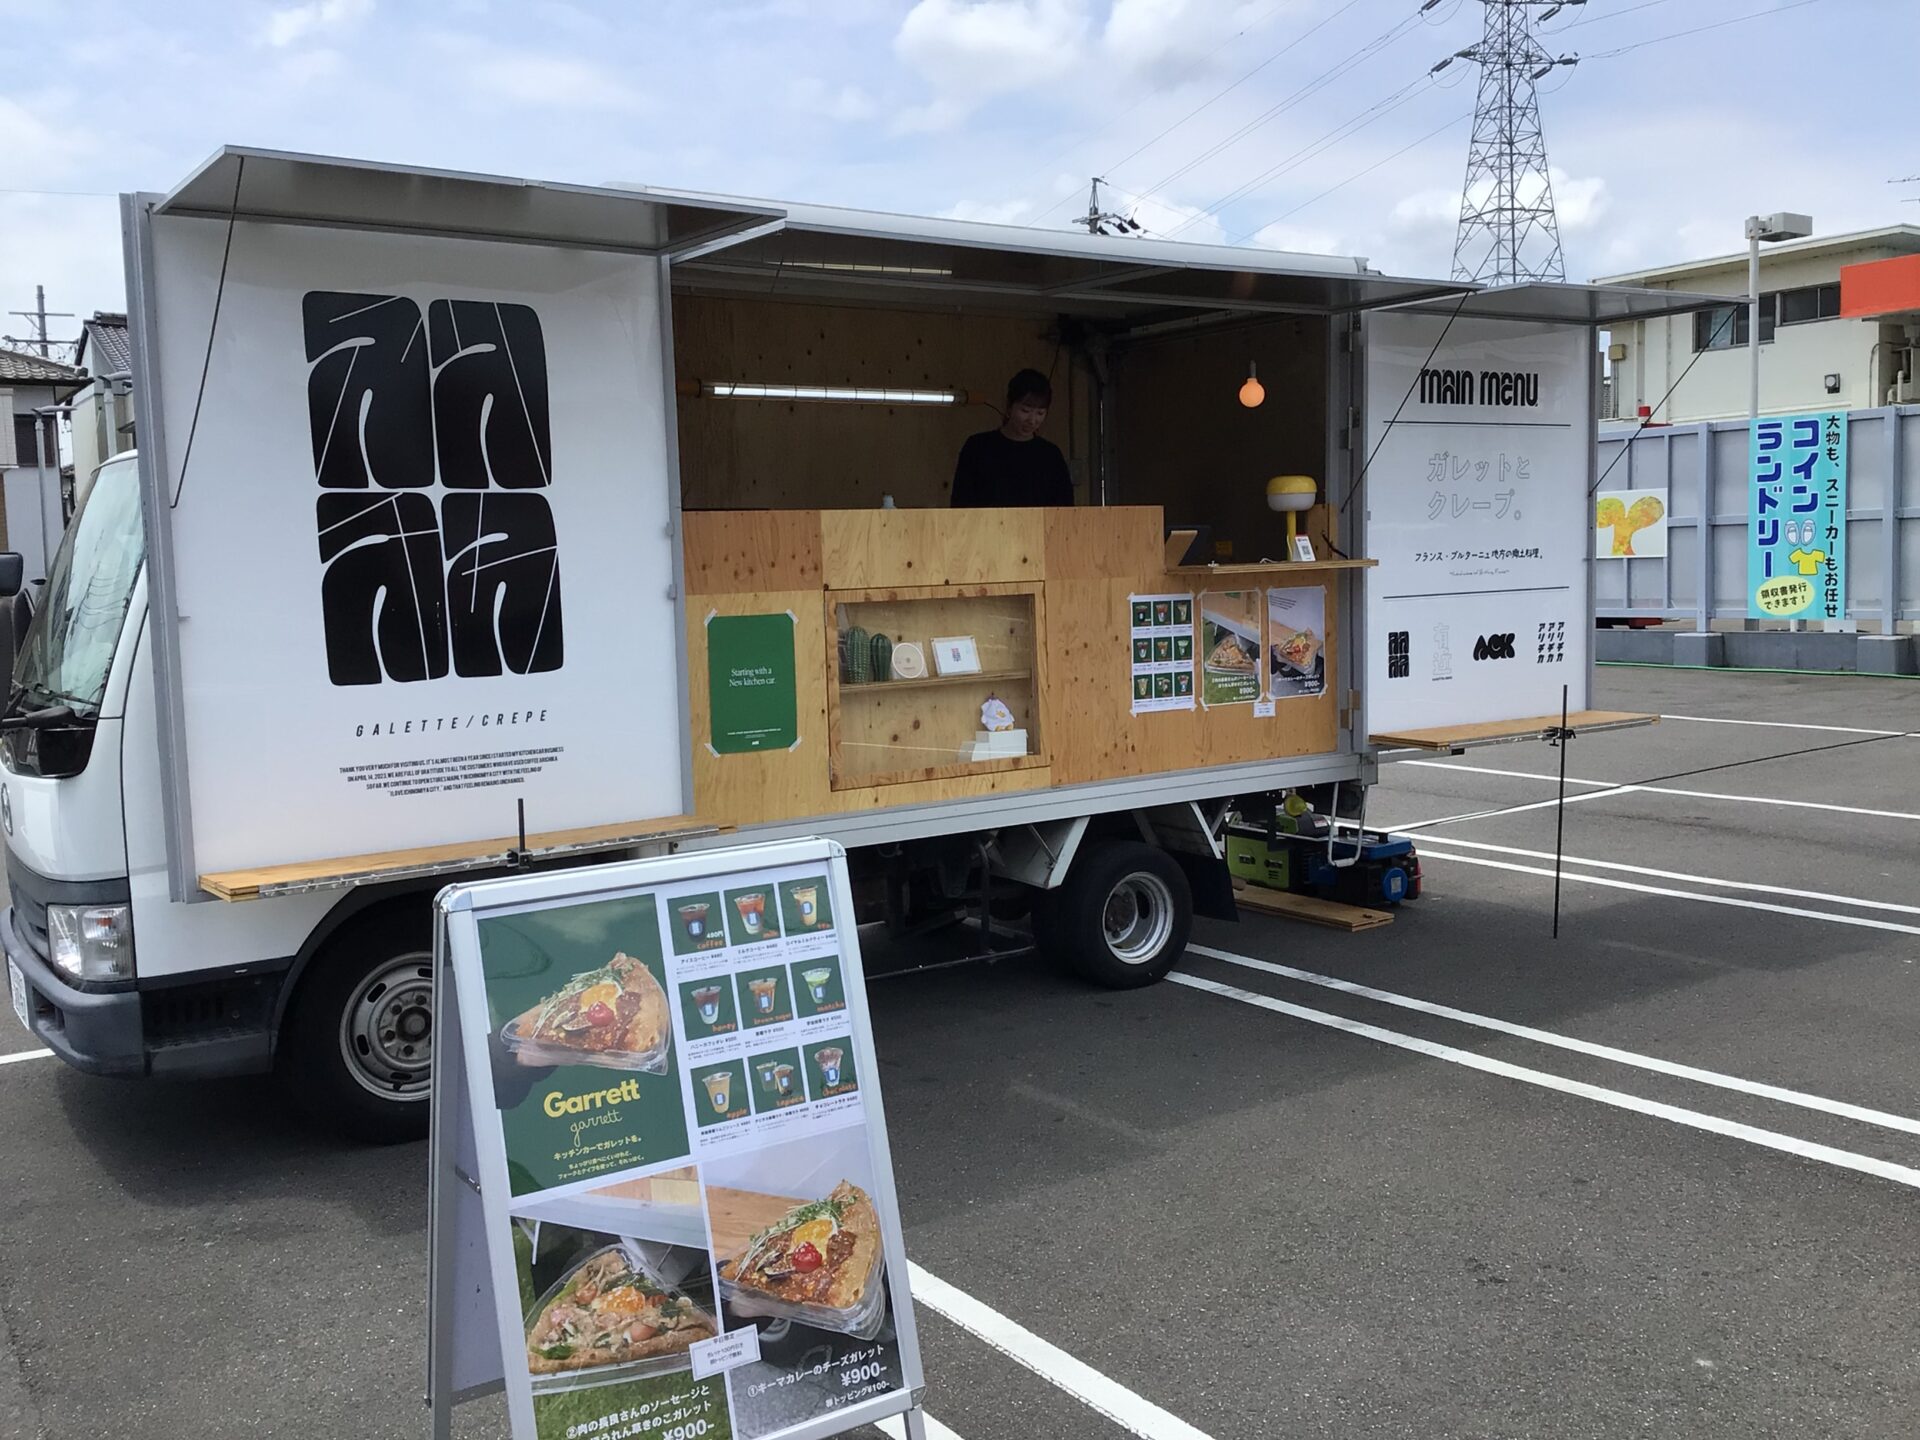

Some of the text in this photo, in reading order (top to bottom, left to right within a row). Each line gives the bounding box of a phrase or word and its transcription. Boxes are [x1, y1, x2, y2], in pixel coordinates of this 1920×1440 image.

[1427, 451, 1531, 482] ガレットと
[1792, 419, 1820, 513] コイン
[1428, 488, 1521, 520] クレープ。
[1756, 422, 1783, 578] ランドリー
[1760, 582, 1807, 599] 領収書発行
[543, 1078, 641, 1118] Garrett
[570, 1109, 623, 1147] garrett
[553, 1135, 642, 1160] キッチンカーでガレットを。
[840, 1361, 887, 1388] ¥900-
